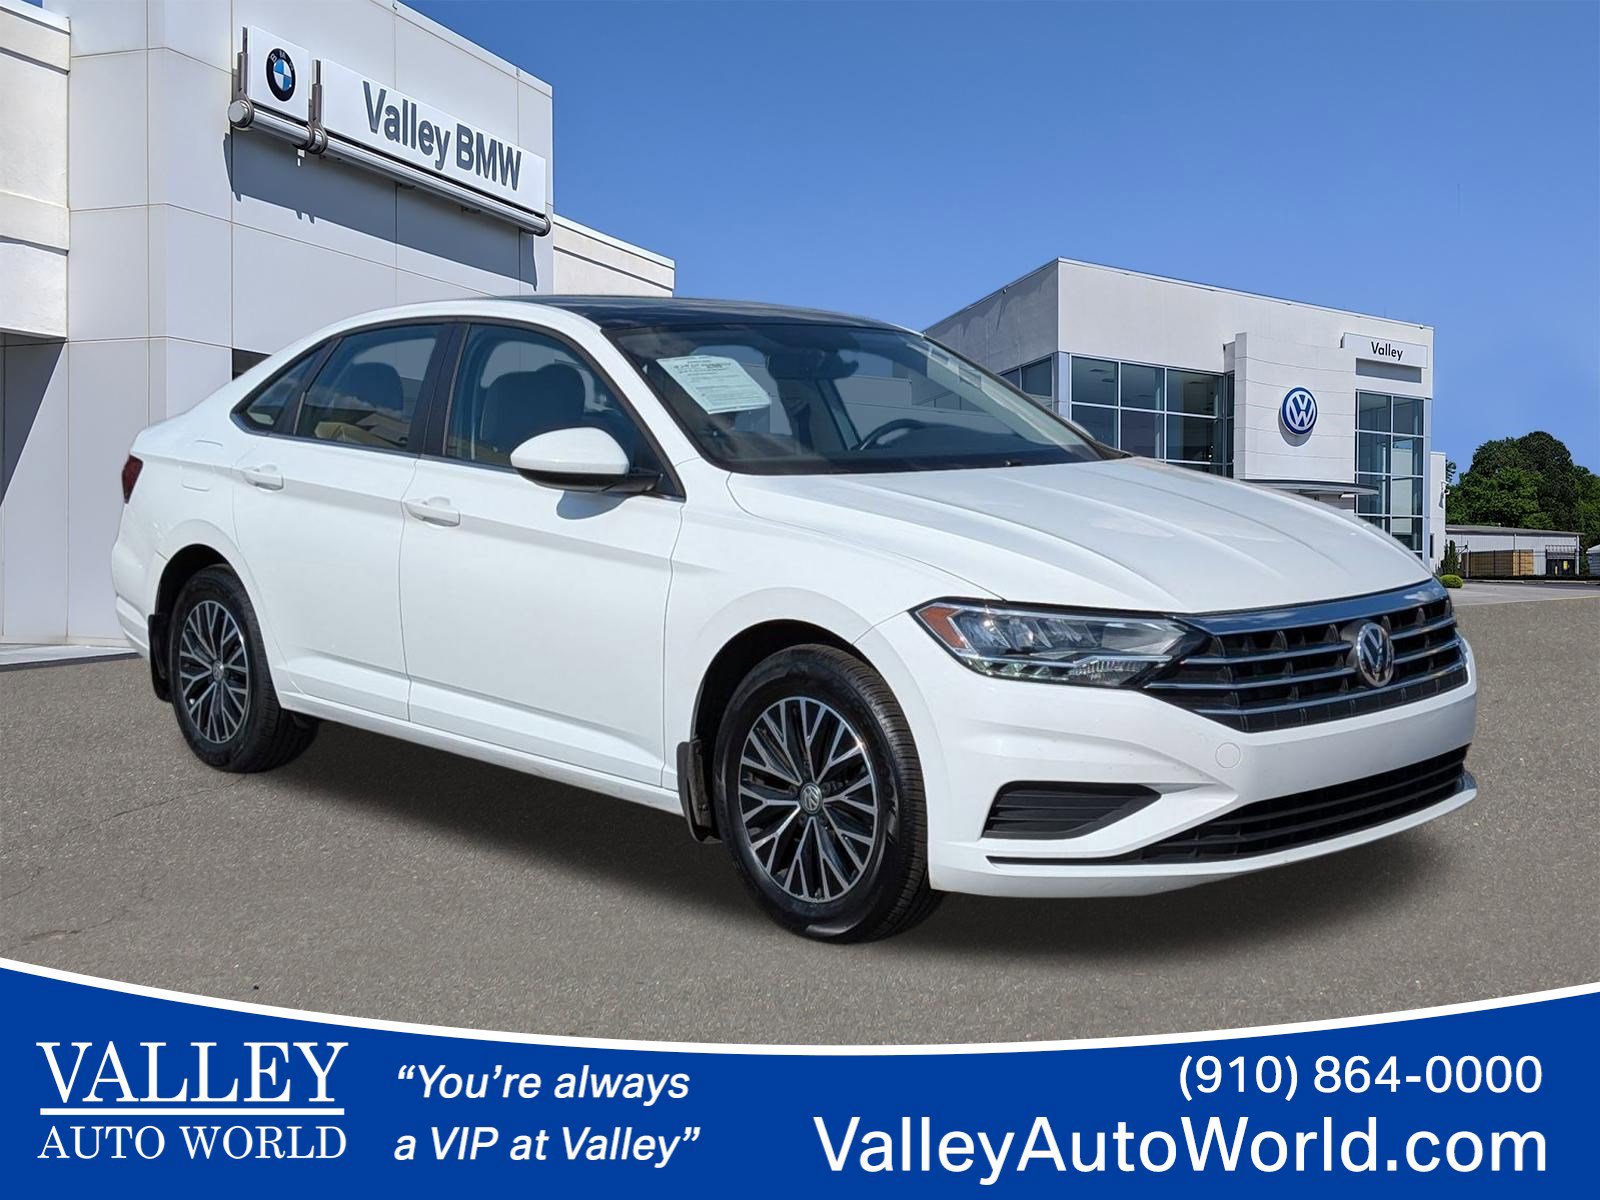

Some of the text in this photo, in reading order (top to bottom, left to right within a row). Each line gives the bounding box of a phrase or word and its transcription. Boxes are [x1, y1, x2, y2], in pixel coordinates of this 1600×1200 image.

[362, 80, 522, 191] Valley BMW
[1371, 341, 1403, 360] Valley
